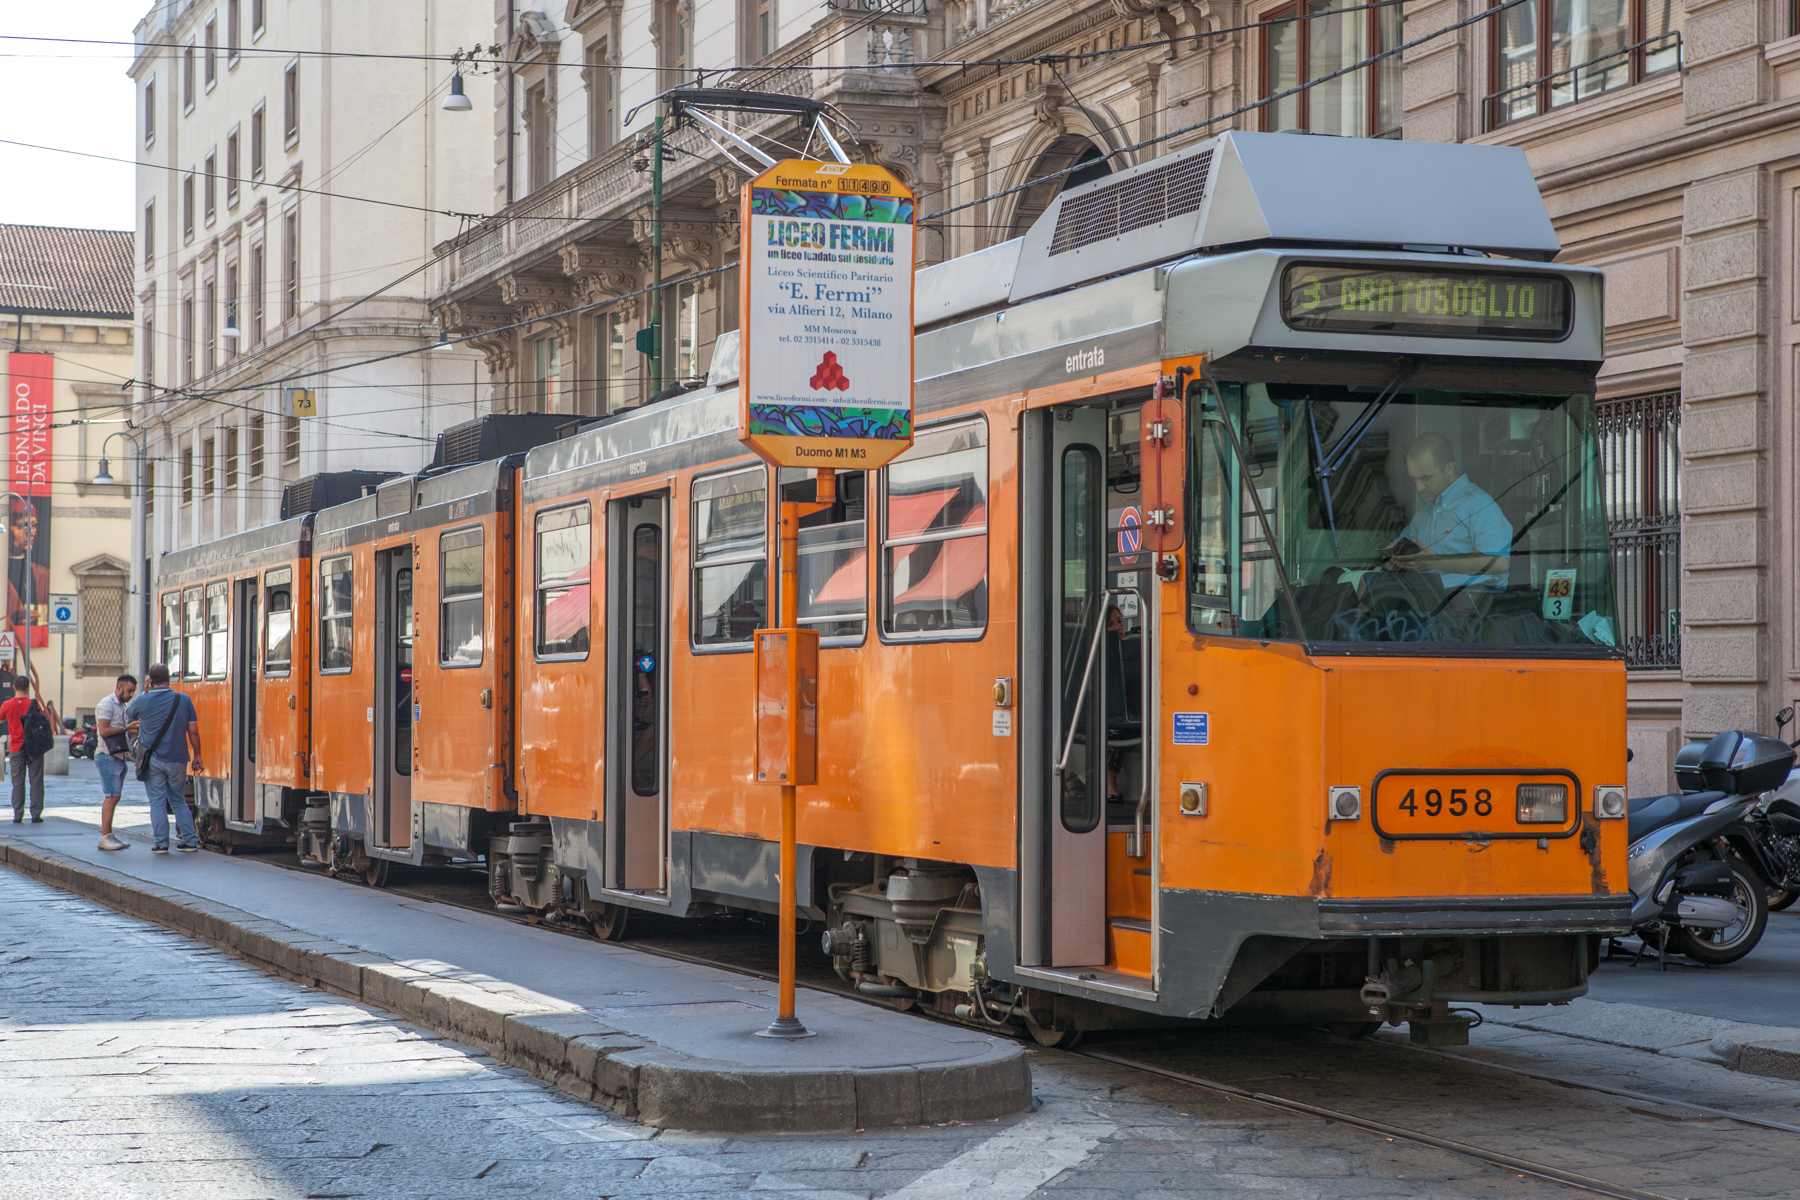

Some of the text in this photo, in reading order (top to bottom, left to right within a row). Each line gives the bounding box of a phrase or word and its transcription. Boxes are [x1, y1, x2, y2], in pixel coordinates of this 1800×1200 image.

[776, 176, 818, 188] Fermata
[838, 178, 890, 194] 11490
[768, 220, 894, 253] LICEO FERMI
[768, 250, 894, 266] un liceo fondato sul desiderio
[768, 266, 894, 282] Liceo Scientifico Paritario
[779, 282, 882, 302] “E. Fermi”
[1301, 276, 1534, 318] 3 GRATOSOGLIO
[768, 304, 892, 320] via Alfieri 12, Milano
[804, 324, 857, 335] MM Moscova
[804, 336, 834, 344] 3315414
[852, 338, 881, 346] 3315438
[1066, 346, 1104, 374] entrata
[757, 394, 827, 403] www.liceofermi.com
[832, 396, 902, 406] info@liceofermi.com
[16, 383, 30, 486] LEONARDO
[32, 404, 47, 486] DA VINCI
[796, 446, 866, 458] Duomo M1 M3
[630, 458, 646, 475] uscita
[1550, 580, 1570, 596] 43
[1552, 600, 1562, 616] 3
[1398, 788, 1492, 817] 4958
